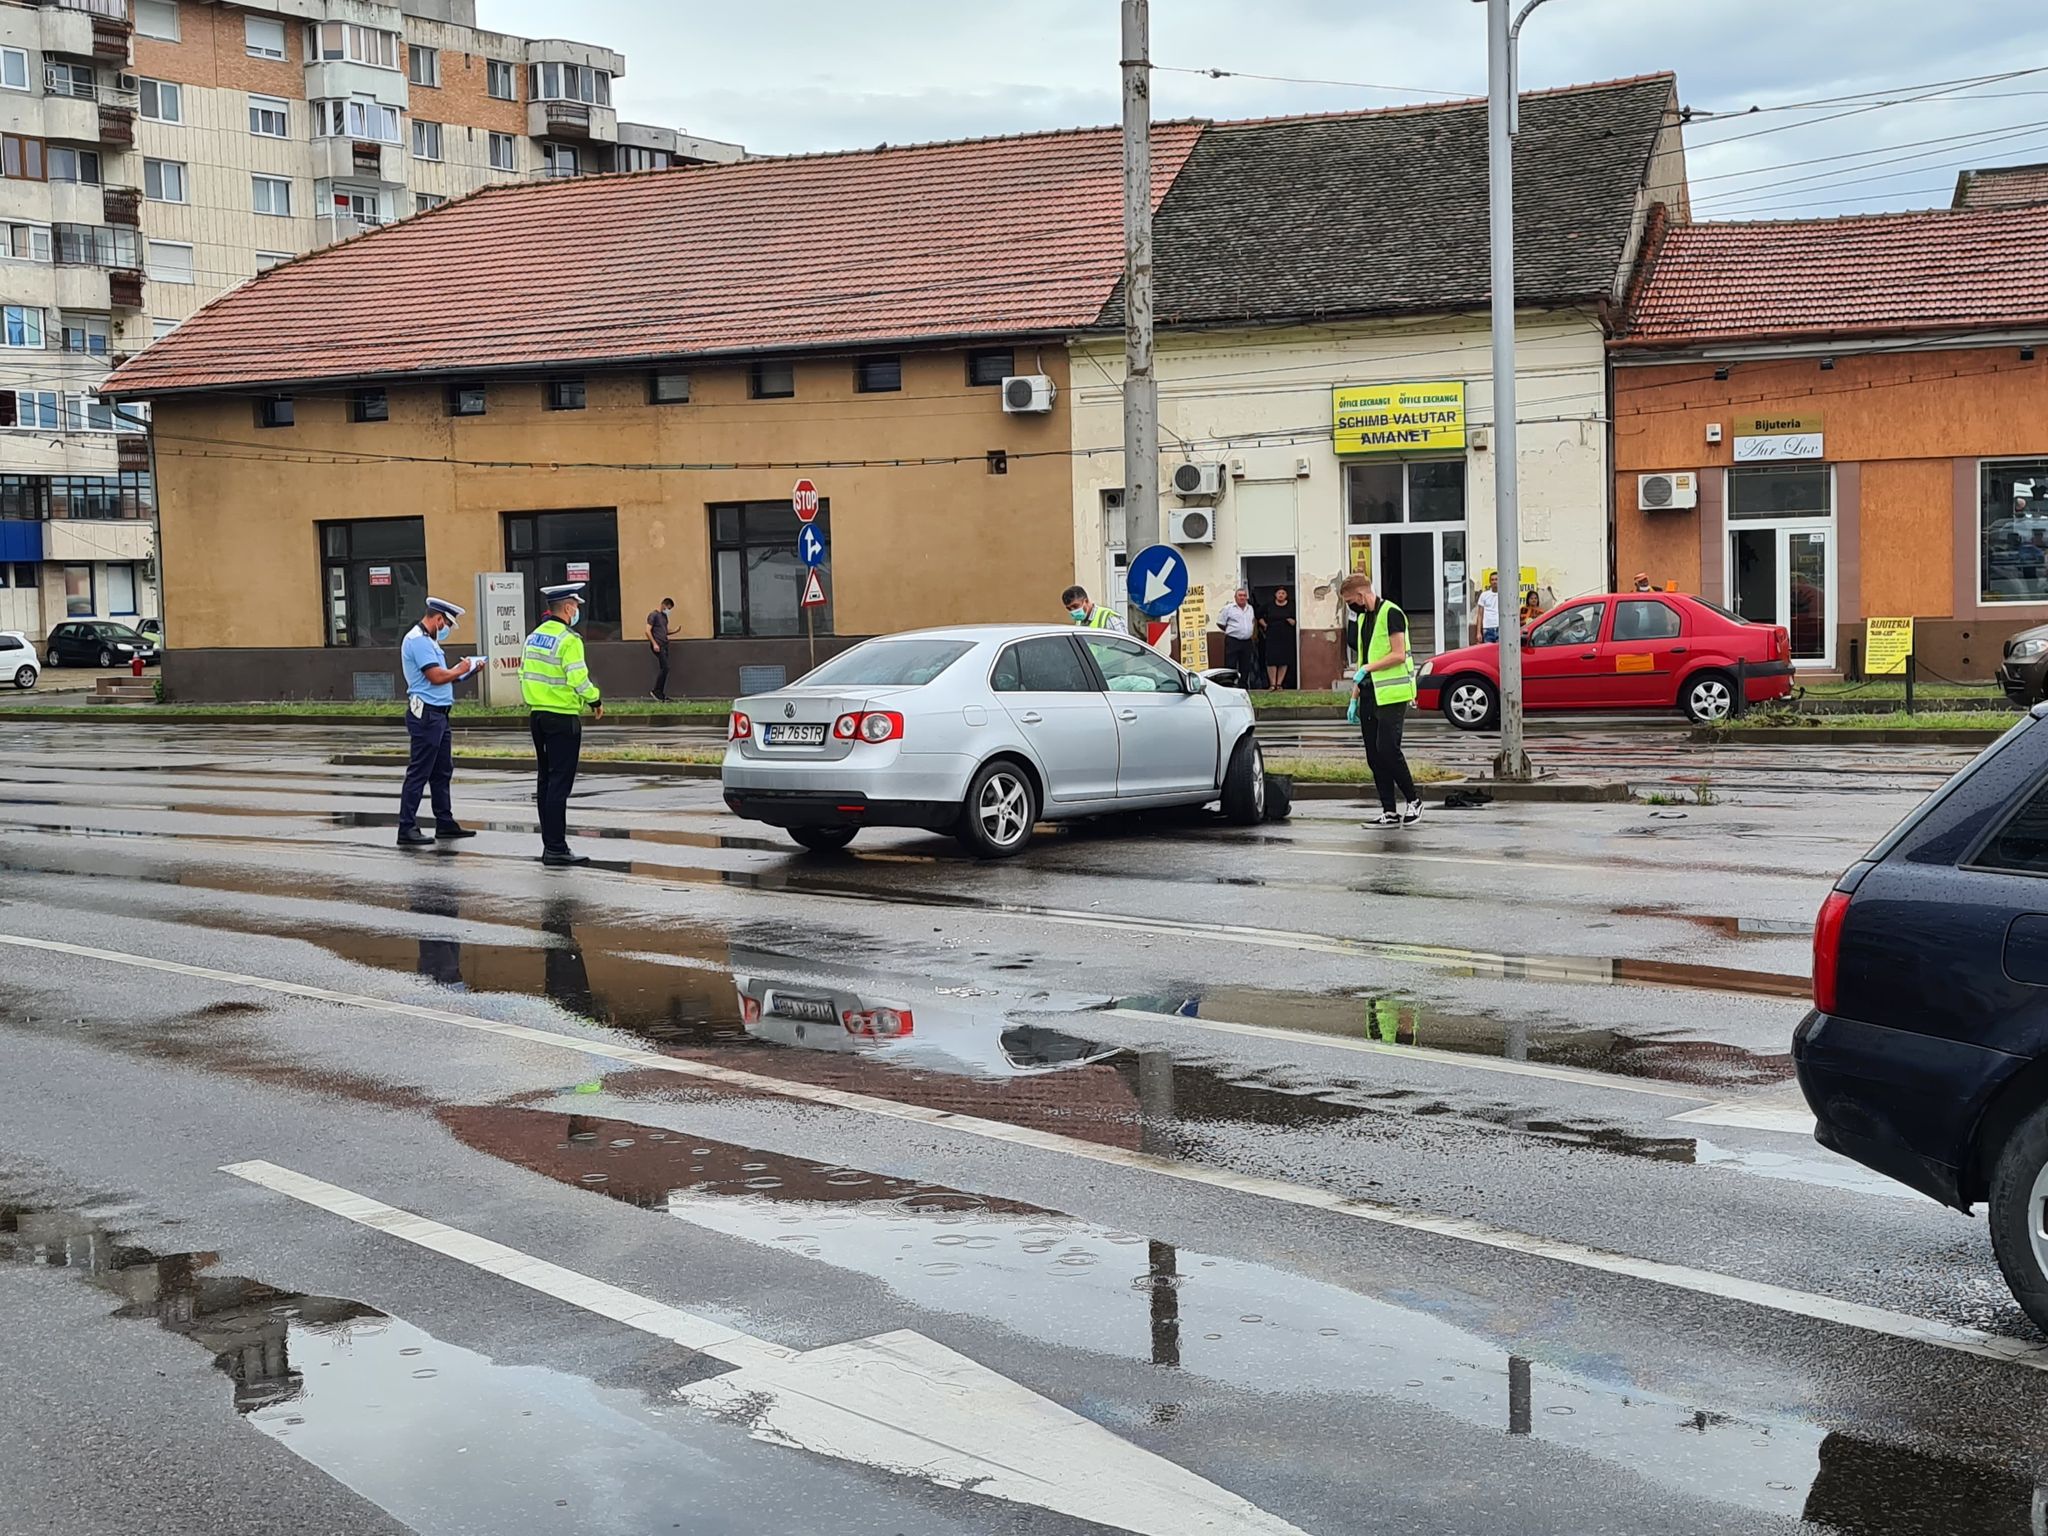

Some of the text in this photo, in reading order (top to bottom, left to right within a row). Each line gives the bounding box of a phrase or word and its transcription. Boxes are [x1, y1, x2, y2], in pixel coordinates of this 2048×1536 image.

[1339, 397, 1390, 408] OFFICE EXCHANGE
[1399, 395, 1458, 404] OFFICE EXCHANGE
[1339, 411, 1456, 428] SCHIMB VALUTAR
[1755, 419, 1801, 432] Bijuteria
[1361, 430, 1430, 444] AMANET
[1739, 438, 1776, 457] Aur
[796, 490, 817, 510] STOP
[497, 605, 516, 617] POMPE
[503, 621, 511, 631] DE
[770, 727, 786, 740] BH
